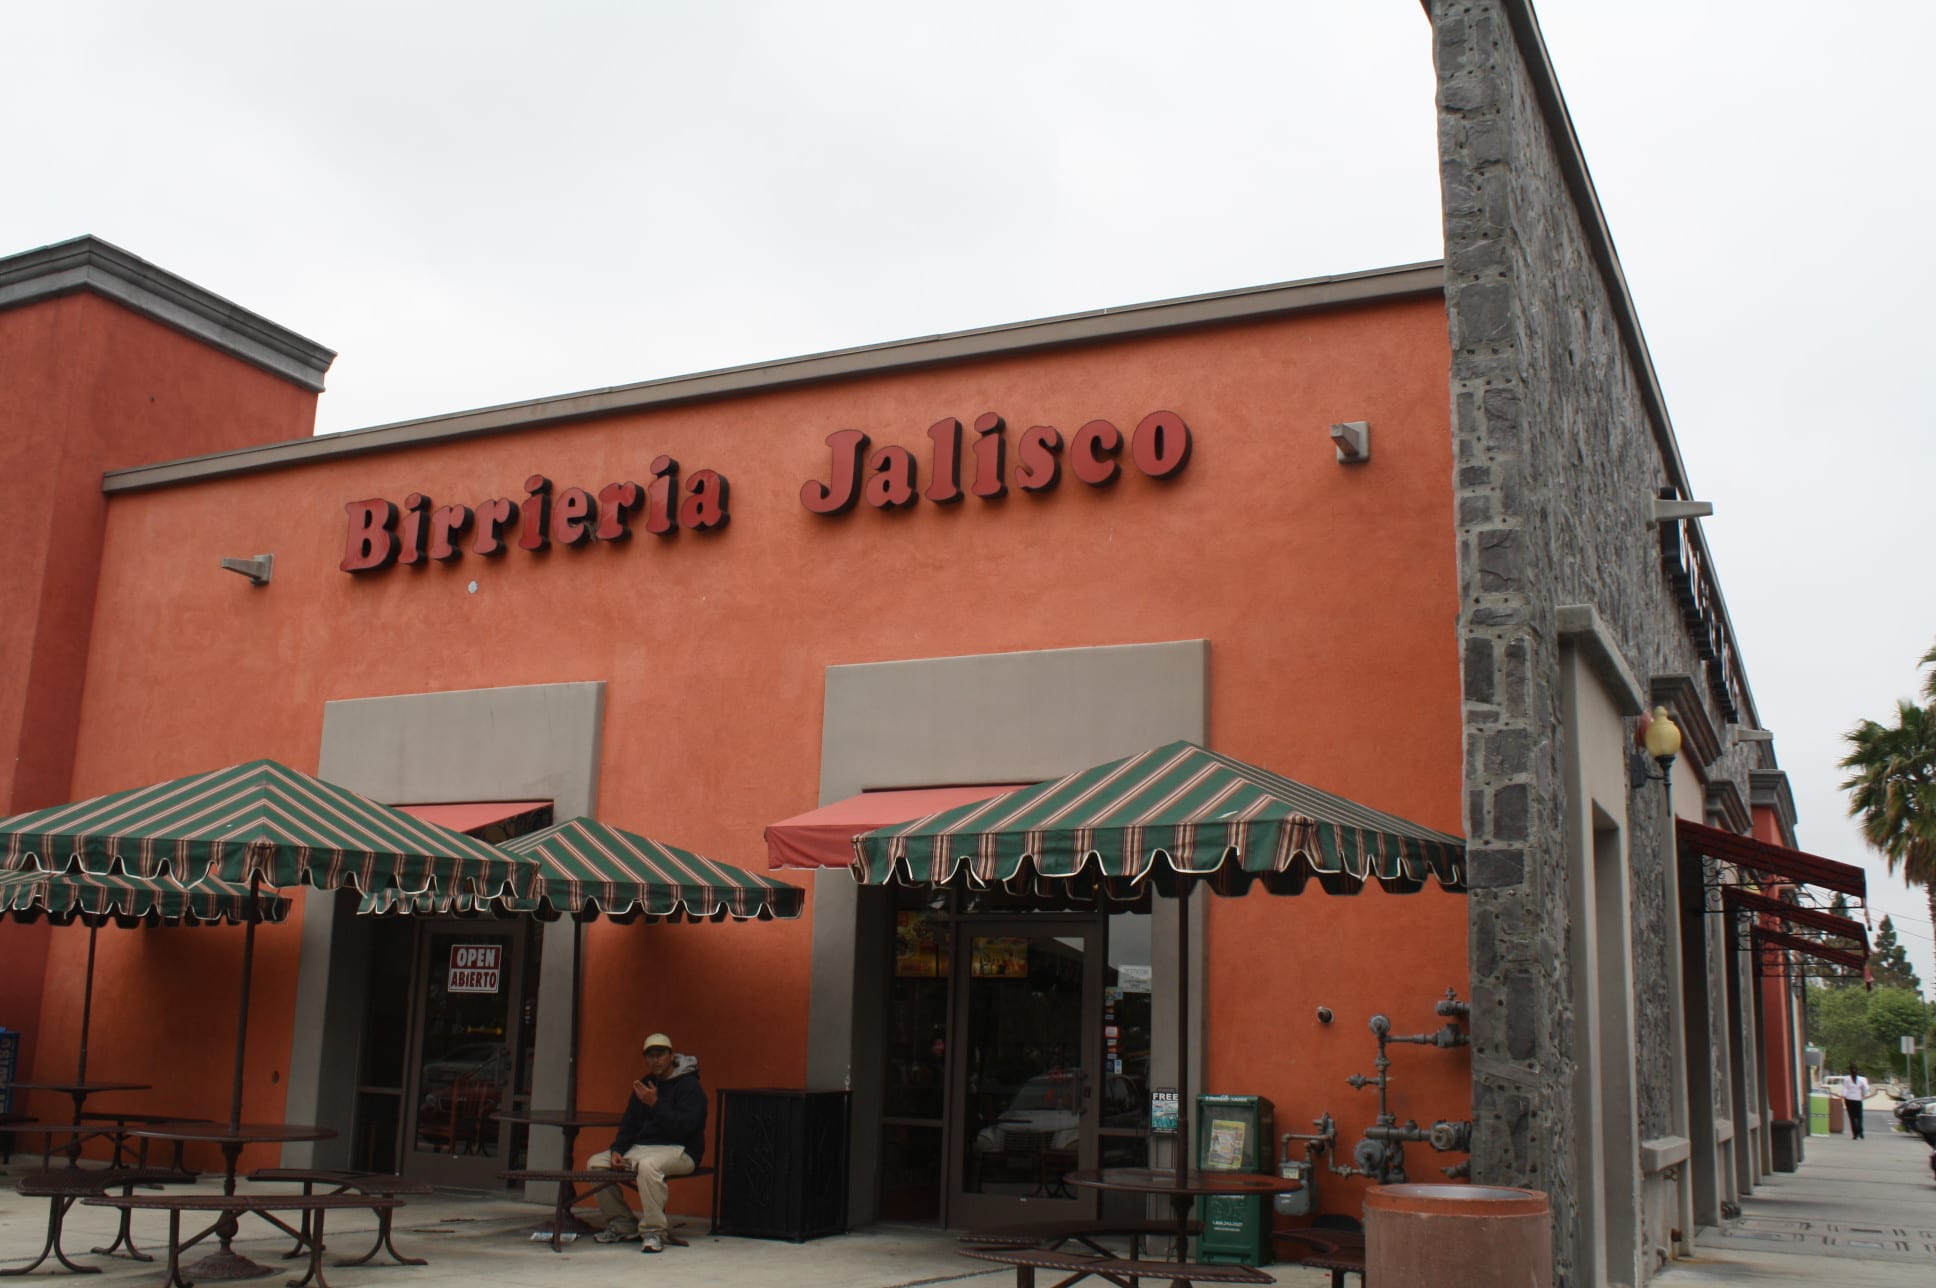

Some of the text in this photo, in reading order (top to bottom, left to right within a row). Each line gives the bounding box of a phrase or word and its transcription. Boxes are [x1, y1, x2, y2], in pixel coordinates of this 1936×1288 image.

[340, 410, 1191, 574] Birrieria Jalisco
[456, 948, 496, 967] OPEN
[450, 971, 497, 988] ABIERTO
[1152, 1092, 1179, 1101] FREE
